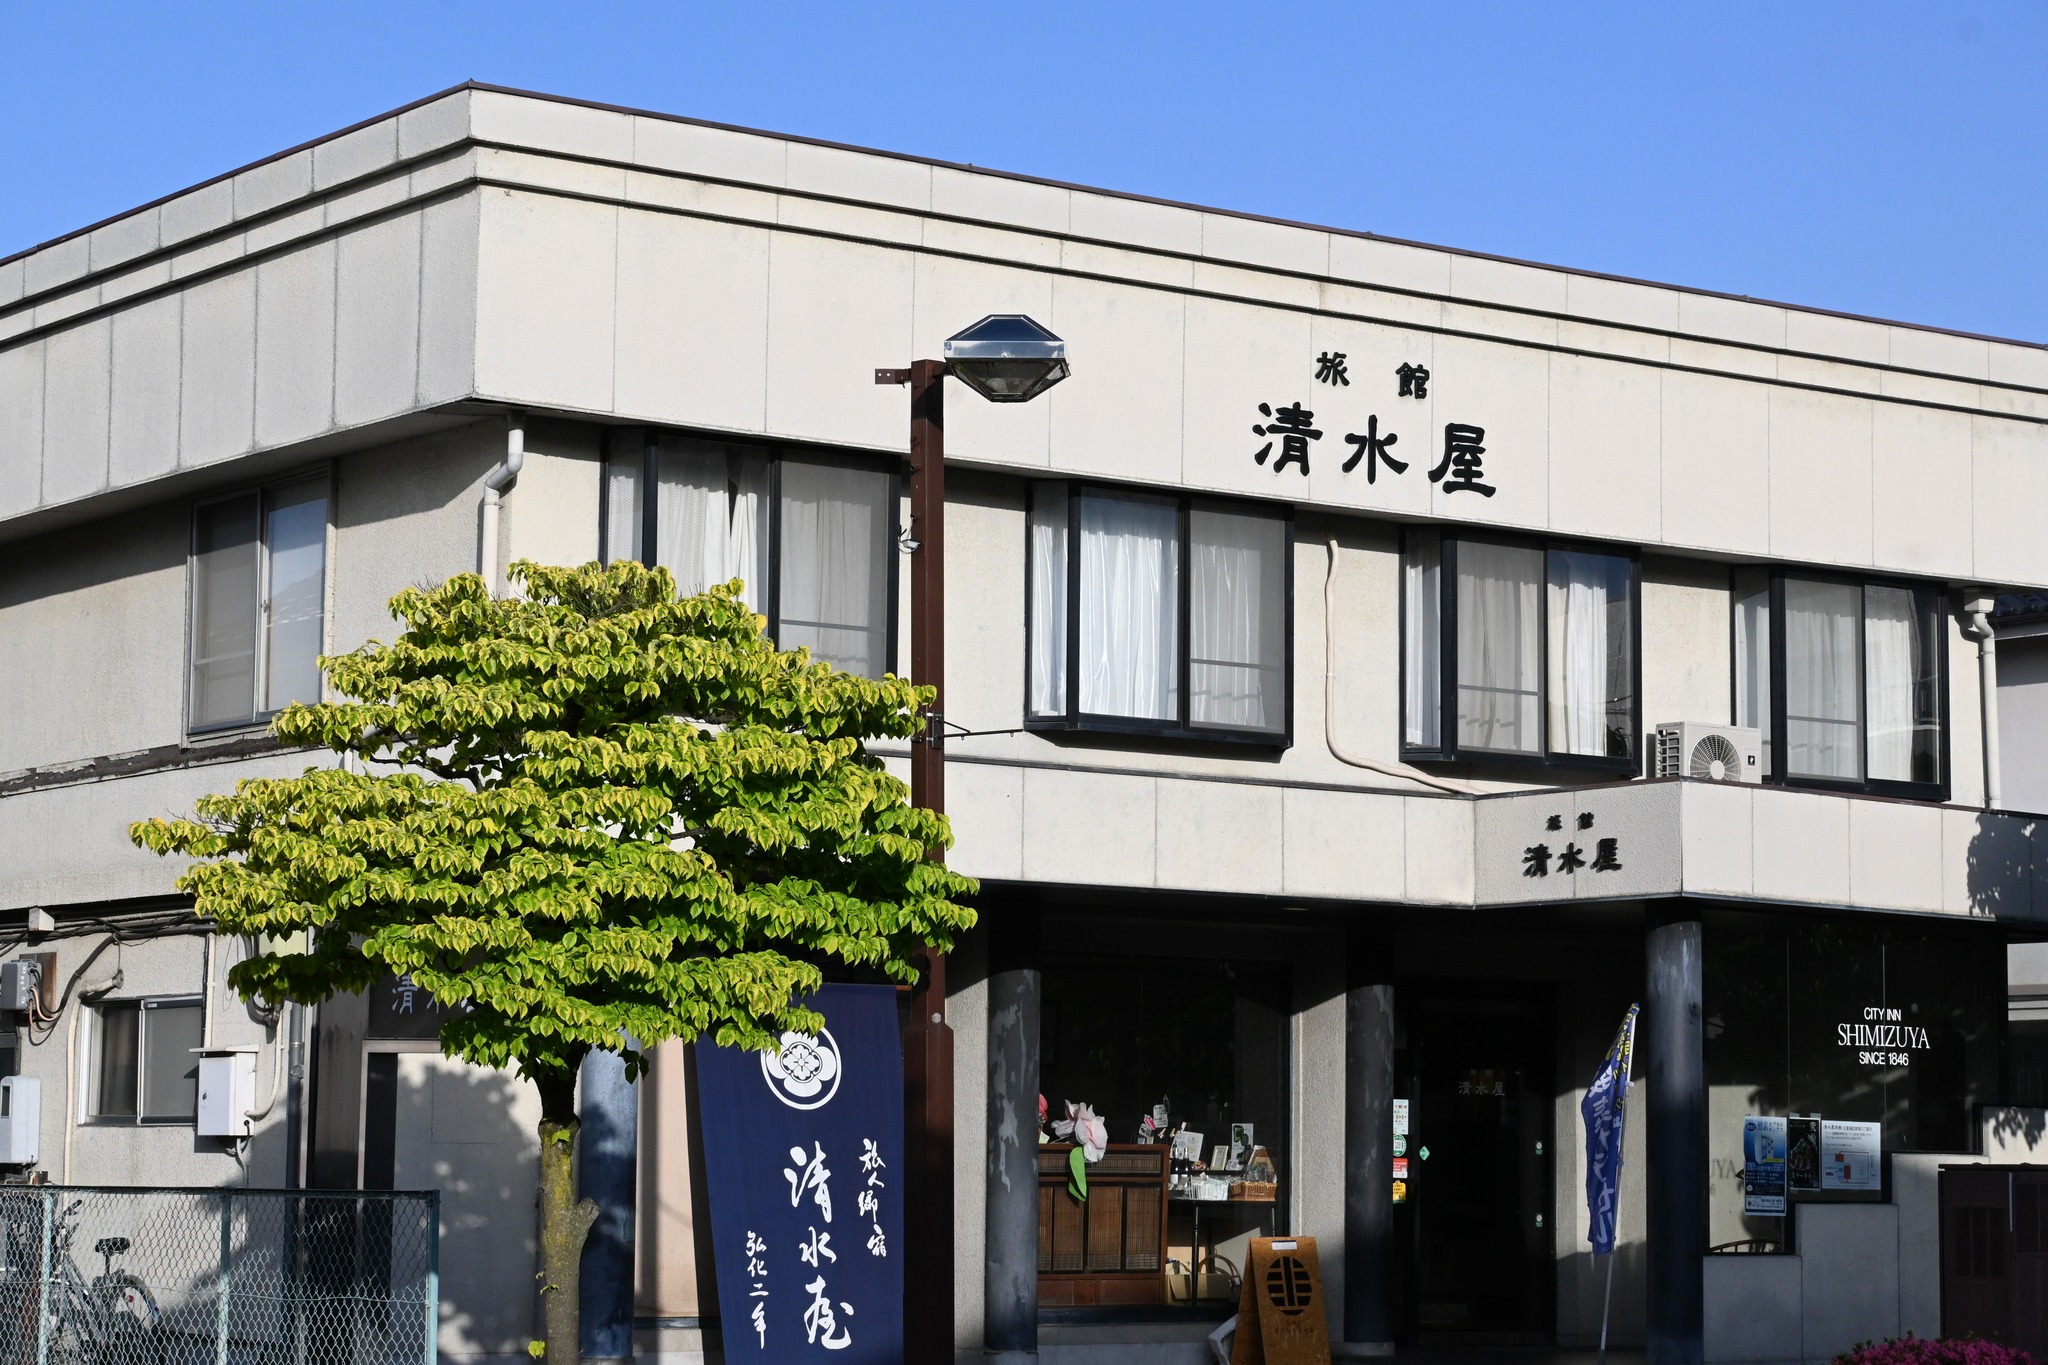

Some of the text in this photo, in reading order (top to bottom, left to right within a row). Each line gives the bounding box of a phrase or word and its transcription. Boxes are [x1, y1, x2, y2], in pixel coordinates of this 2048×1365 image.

[1315, 351, 1430, 400] 旅館
[1252, 401, 1497, 498] 清水屋
[1521, 837, 1623, 878] 清水屋
[1863, 1007, 1902, 1022] CITY INN
[1837, 1023, 1931, 1049] SHIMIZUYA
[1859, 1051, 1909, 1067] SINCE 1846
